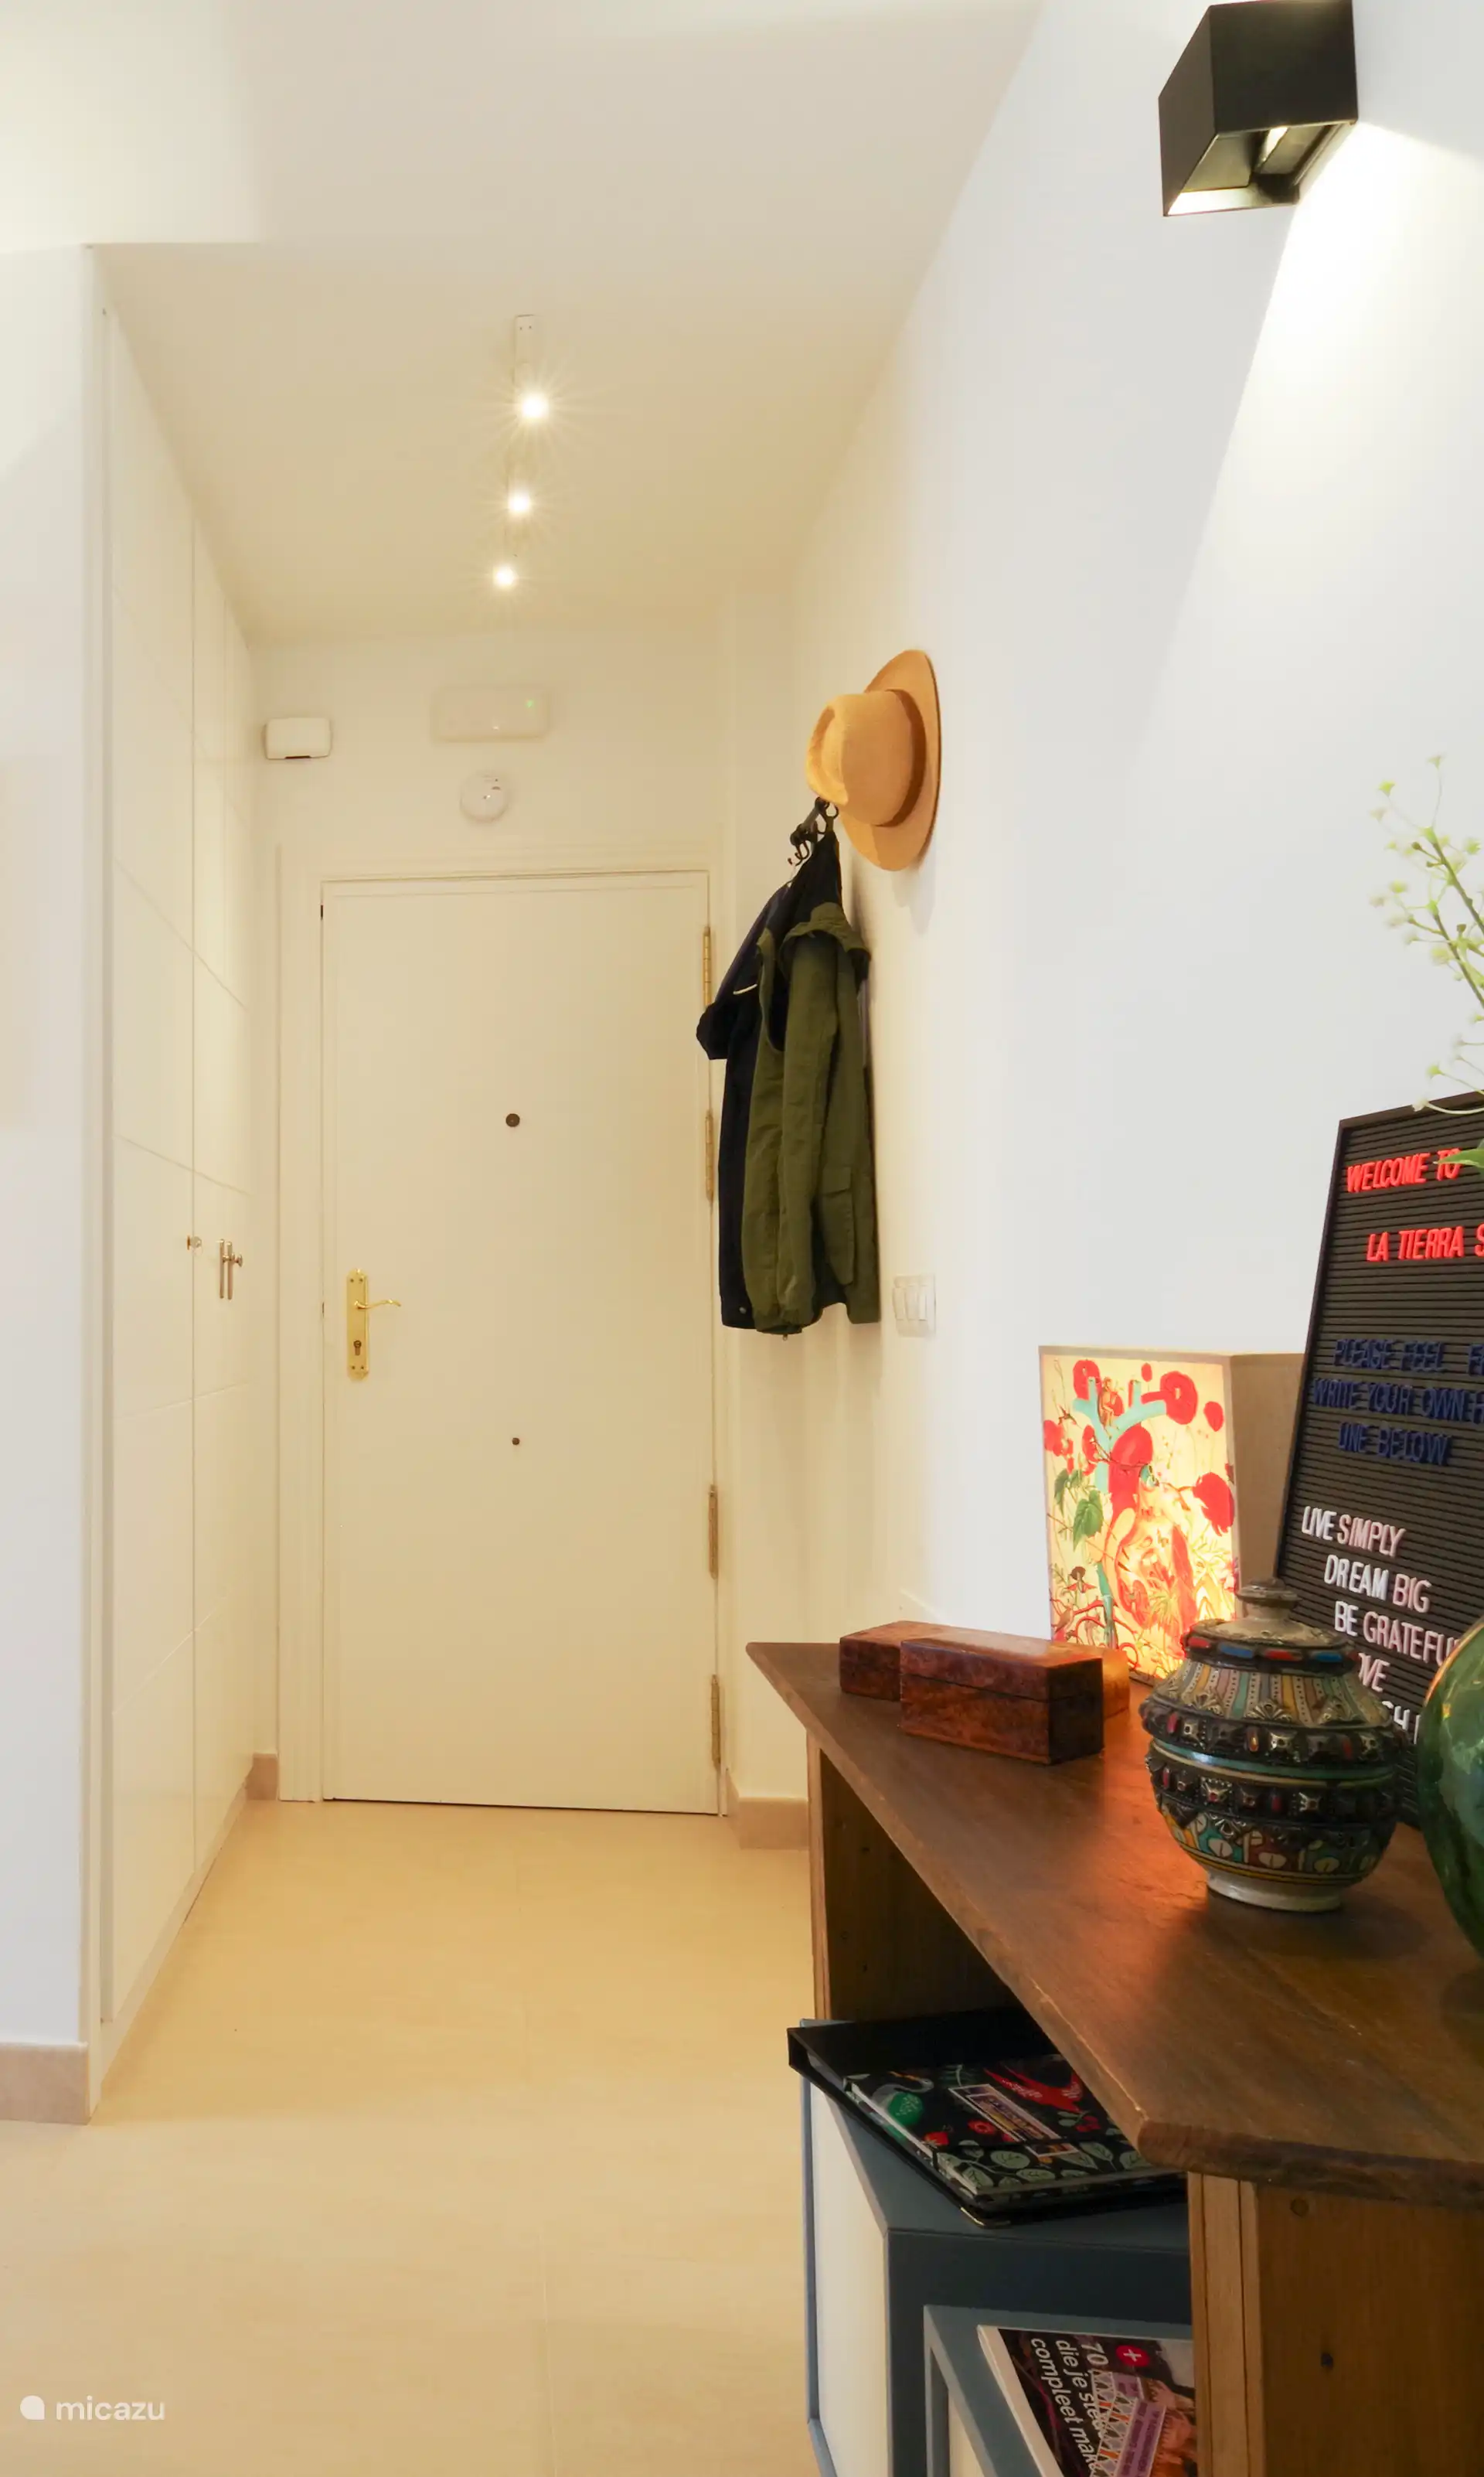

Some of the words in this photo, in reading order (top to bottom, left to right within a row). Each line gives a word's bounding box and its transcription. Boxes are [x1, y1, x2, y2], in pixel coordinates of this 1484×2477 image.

[1347, 1153, 1430, 1192] WELCOME
[1437, 1148, 1462, 1181] TO
[1367, 1232, 1389, 1262] LA
[1398, 1226, 1464, 1260] TIERRA
[1401, 1341, 1445, 1371] FEEL
[1314, 1378, 1363, 1409] WRITE
[1368, 1382, 1413, 1415] YOUR
[1421, 1388, 1465, 1421] OWN
[1339, 1422, 1370, 1453] LINE
[1377, 1428, 1452, 1465] BELOW
[1302, 1506, 1337, 1541] LIVE
[1337, 1514, 1407, 1557] SIMPLY
[1324, 1554, 1390, 1601] DREAM
[1393, 1573, 1432, 1613] BIG
[1335, 1600, 1359, 1637] BE
[1363, 1611, 1460, 1667] GRATEFU
[1358, 1652, 1390, 1692] VE
[1056, 2339, 1079, 2368] die
[1081, 2342, 1108, 2366] 70
[1031, 2338, 1084, 2424] compleet
[1064, 2368, 1089, 2389] je
